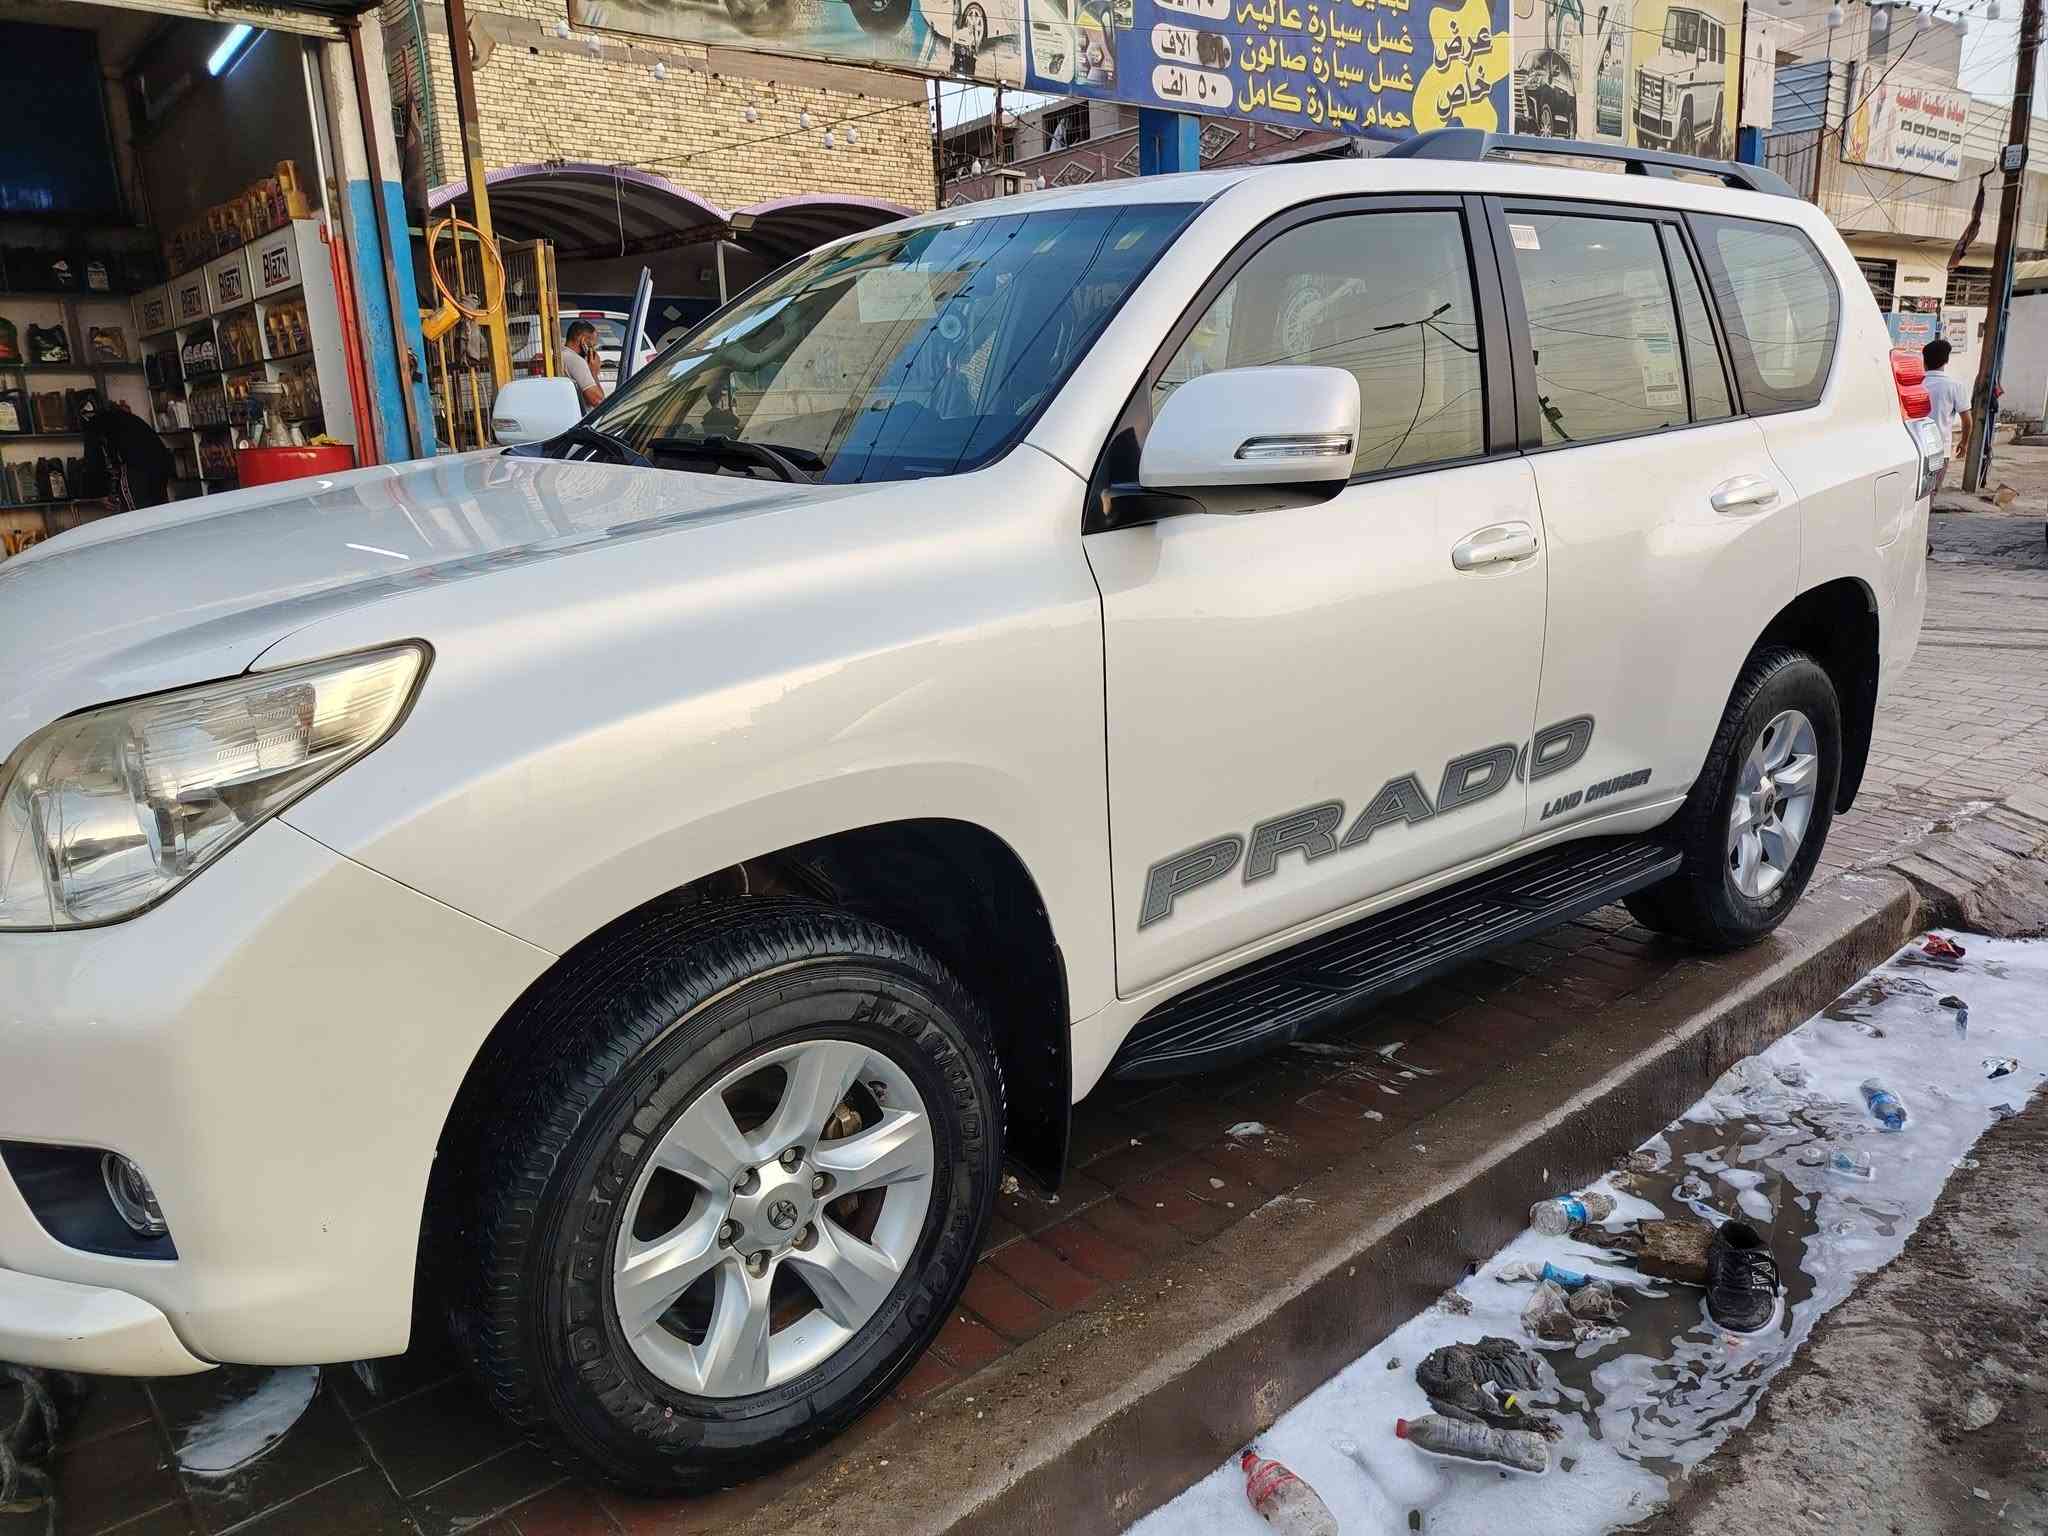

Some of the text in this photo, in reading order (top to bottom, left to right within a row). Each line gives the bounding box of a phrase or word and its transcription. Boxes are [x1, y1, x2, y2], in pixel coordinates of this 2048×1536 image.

[1308, 5, 1362, 48] سيارة
[1367, 18, 1414, 54] غسل
[1434, 20, 1493, 73] عرض
[1240, 36, 1307, 73] صالون
[1312, 46, 1364, 88] سيارة
[1369, 56, 1414, 93] غسل
[1238, 75, 1411, 129] حمام سيارة كامل
[1437, 64, 1492, 121] خاص
[1138, 715, 1595, 931] PRADO
[1540, 790, 1583, 820] LAND
